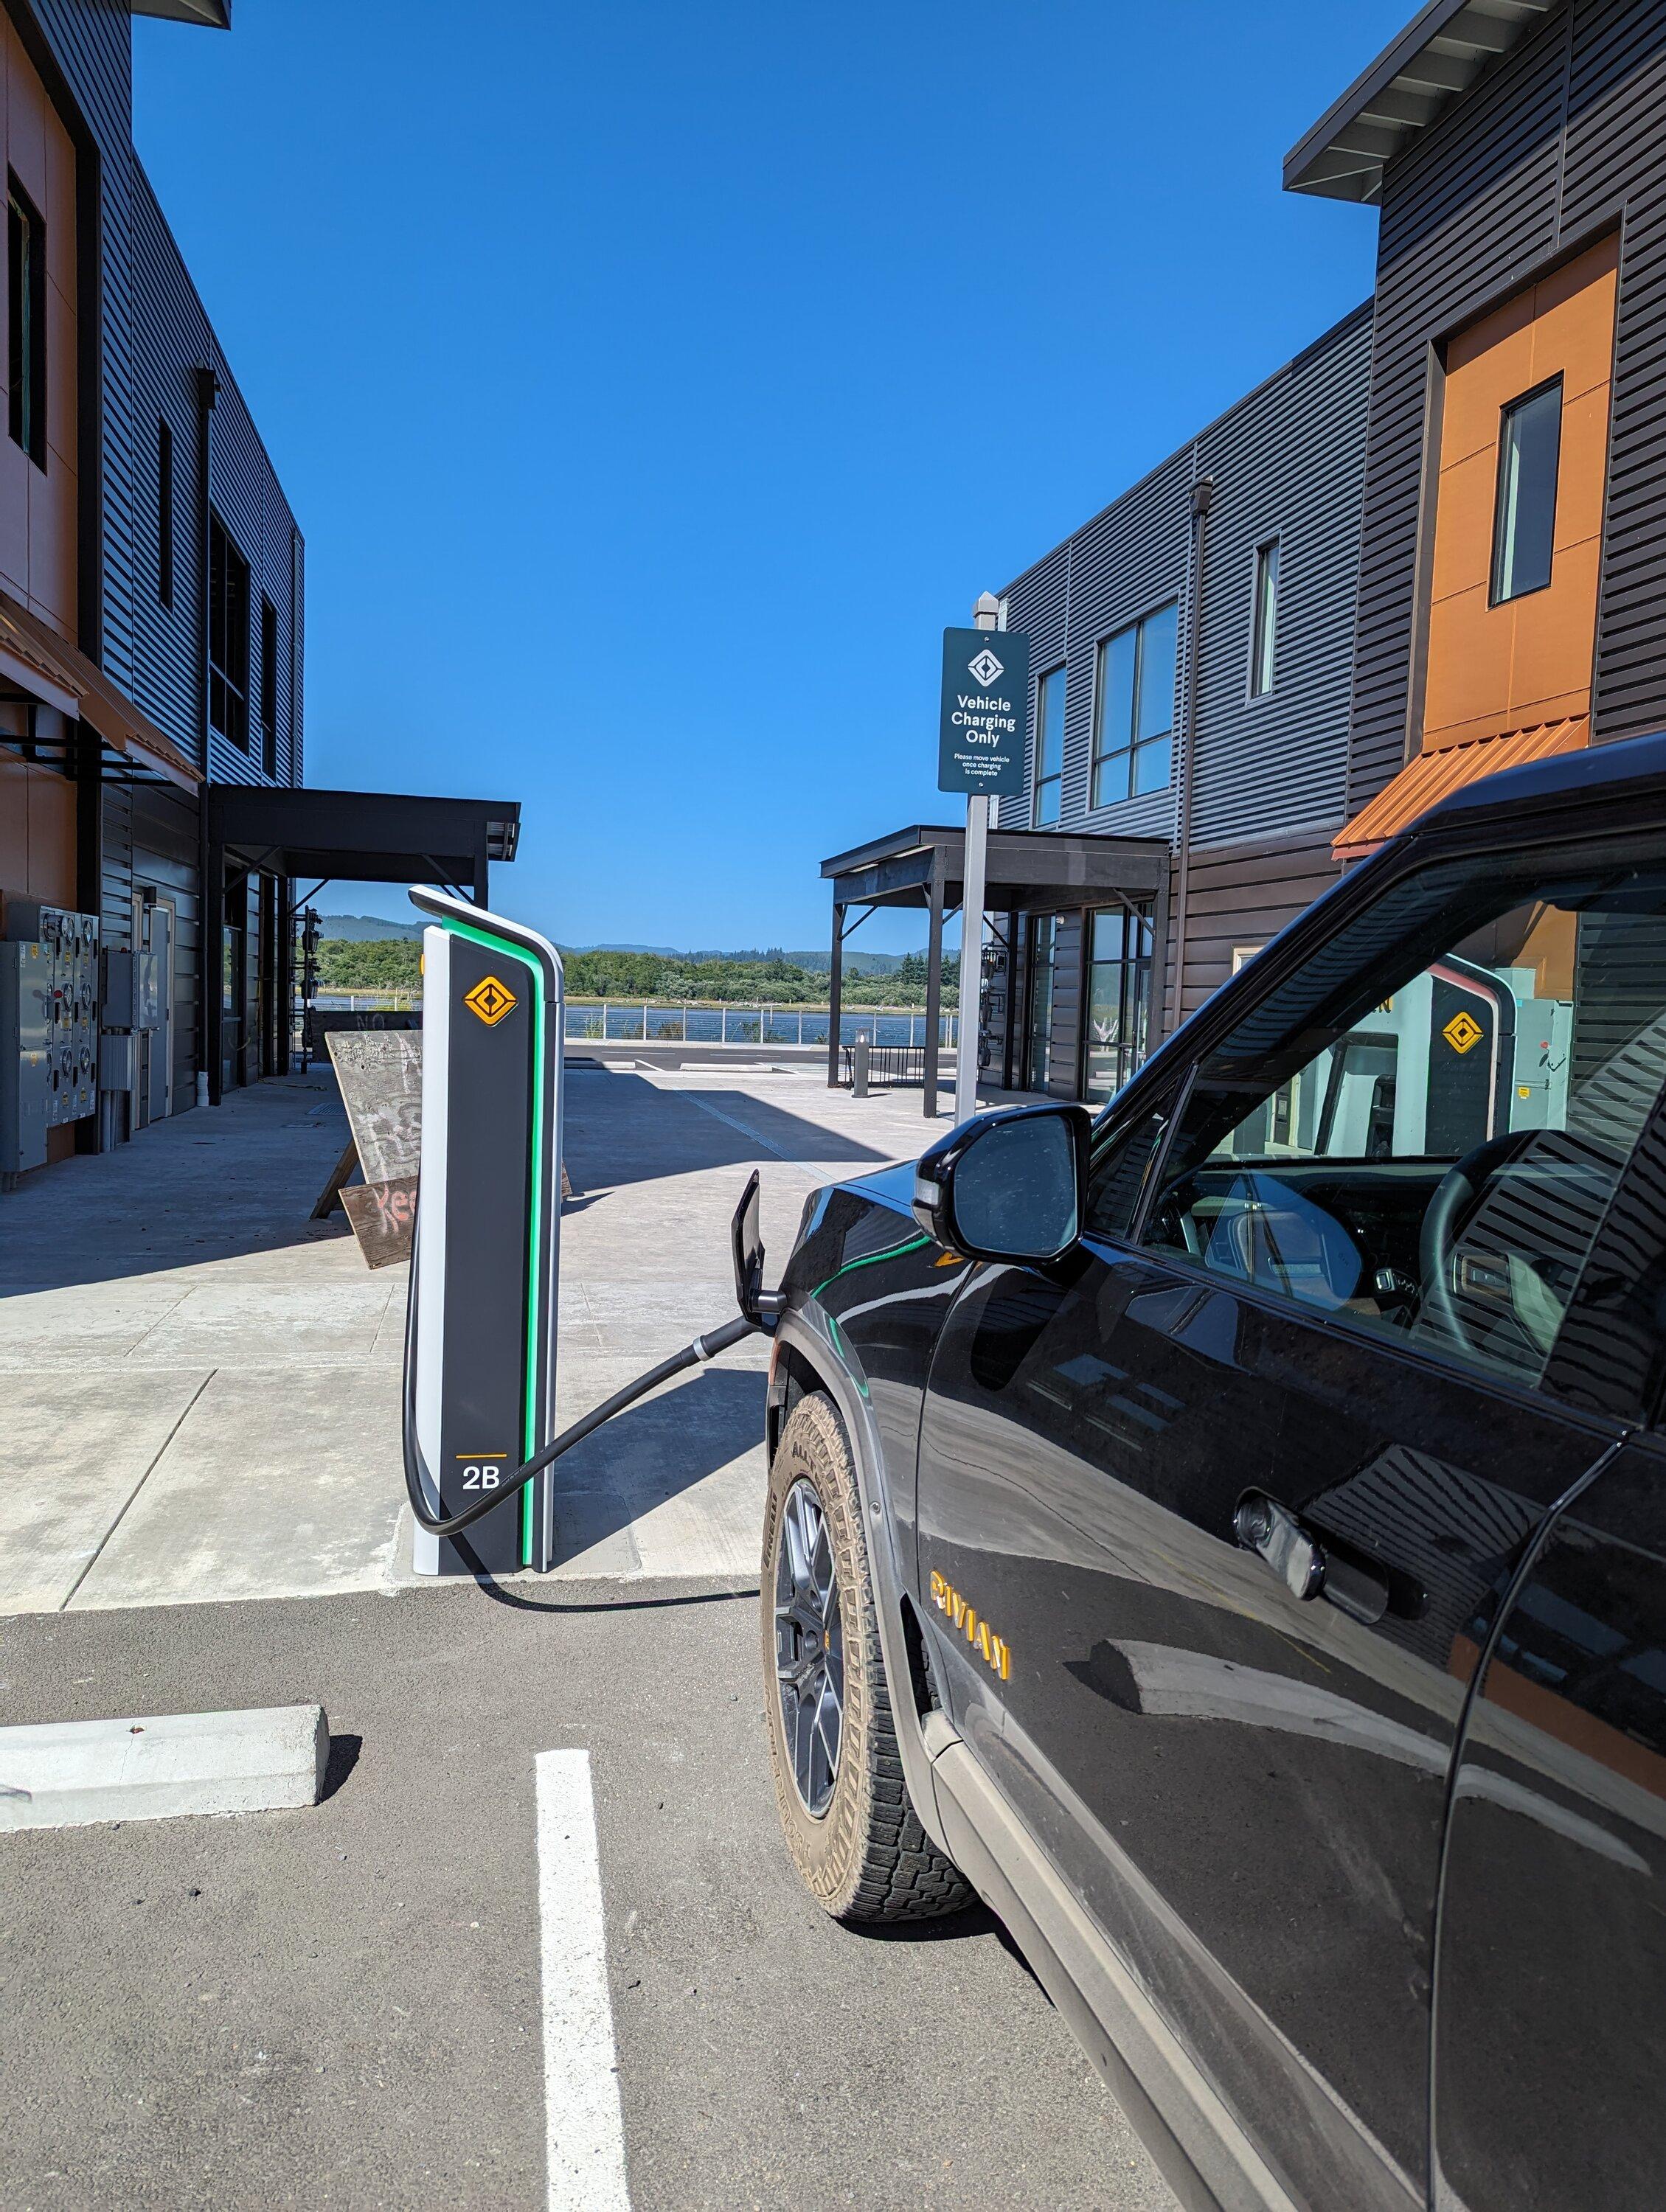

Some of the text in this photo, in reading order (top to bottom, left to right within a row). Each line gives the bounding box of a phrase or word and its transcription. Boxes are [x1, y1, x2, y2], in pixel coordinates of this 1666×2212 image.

[957, 695, 1011, 712] Vehicle
[951, 712, 1016, 732] Charging
[966, 729, 1000, 748] Only
[971, 769, 998, 777] complete
[977, 762, 1002, 771] charging
[462, 1466, 500, 1490] 2B
[930, 1570, 1011, 1680] RIVIAN
